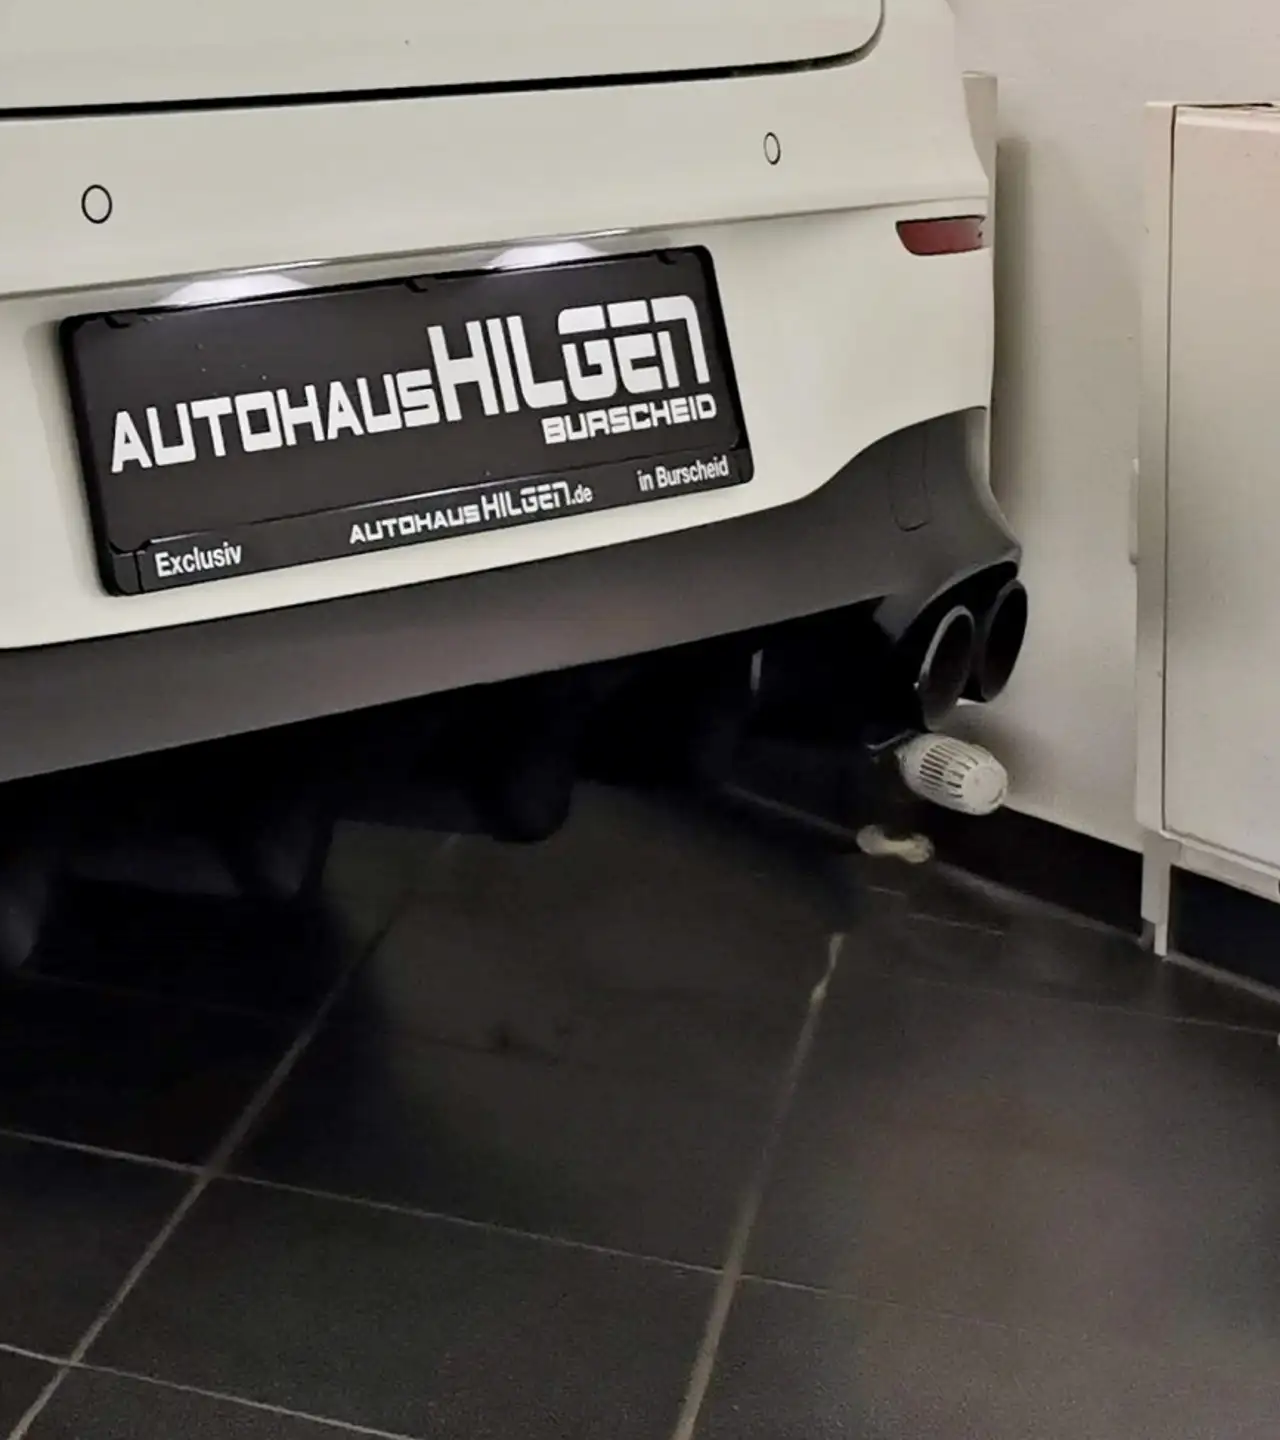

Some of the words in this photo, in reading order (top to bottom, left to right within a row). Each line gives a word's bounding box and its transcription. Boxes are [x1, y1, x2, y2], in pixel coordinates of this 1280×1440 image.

[541, 393, 718, 445] BURSCHEID
[154, 541, 243, 578] Exclusiv
[637, 469, 653, 492] in
[655, 455, 730, 489] Burscheid
